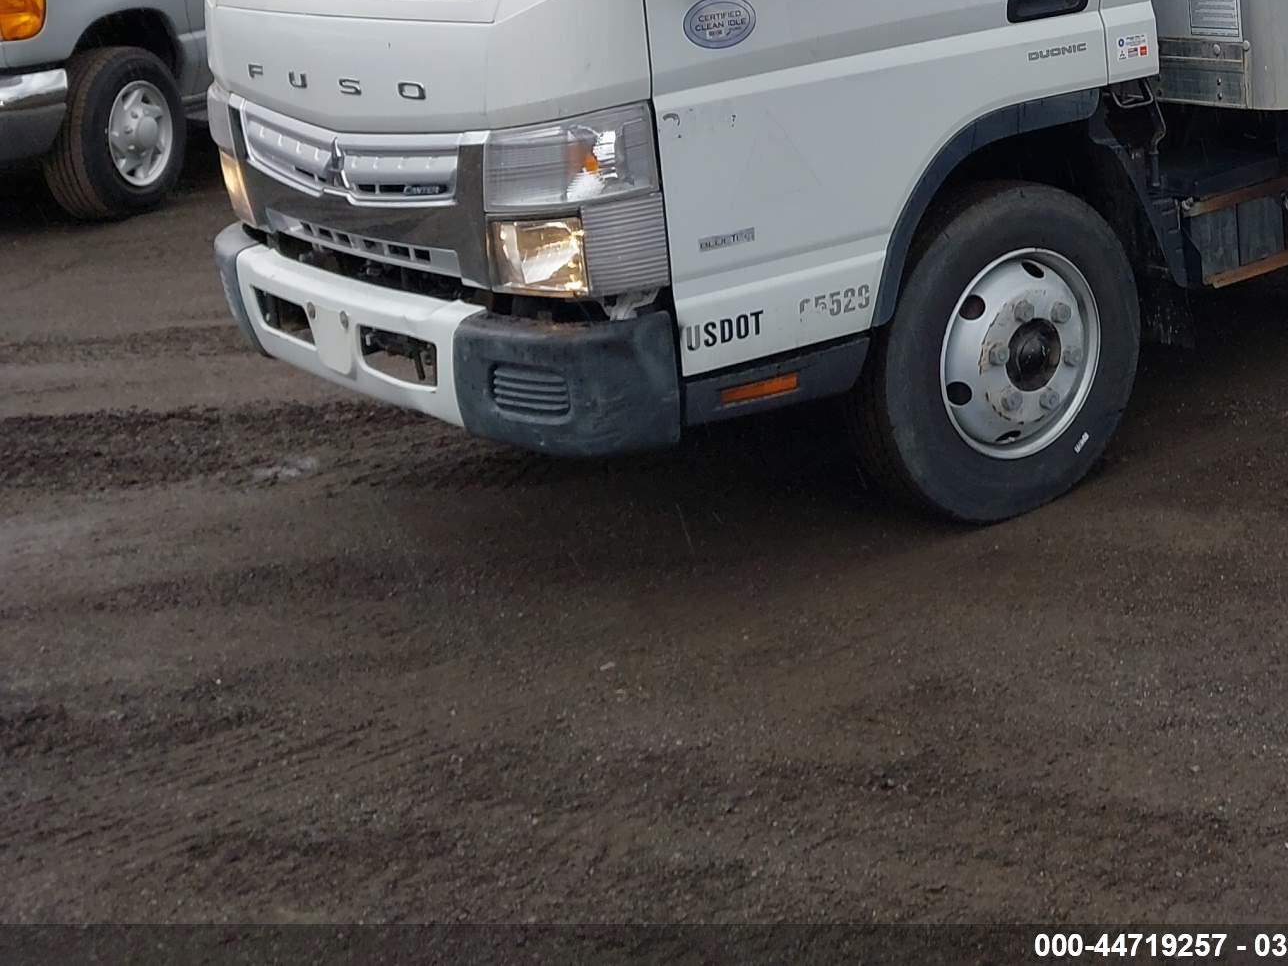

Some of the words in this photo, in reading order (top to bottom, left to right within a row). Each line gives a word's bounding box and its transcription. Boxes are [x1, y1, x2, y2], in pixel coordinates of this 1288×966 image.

[695, 22, 724, 31] CLEAN
[728, 18, 746, 26] IDLE
[698, 10, 741, 22] CERTIFIED
[1028, 42, 1087, 61] DUONIC
[248, 64, 427, 100] FUSO
[686, 309, 764, 351] USDOT
